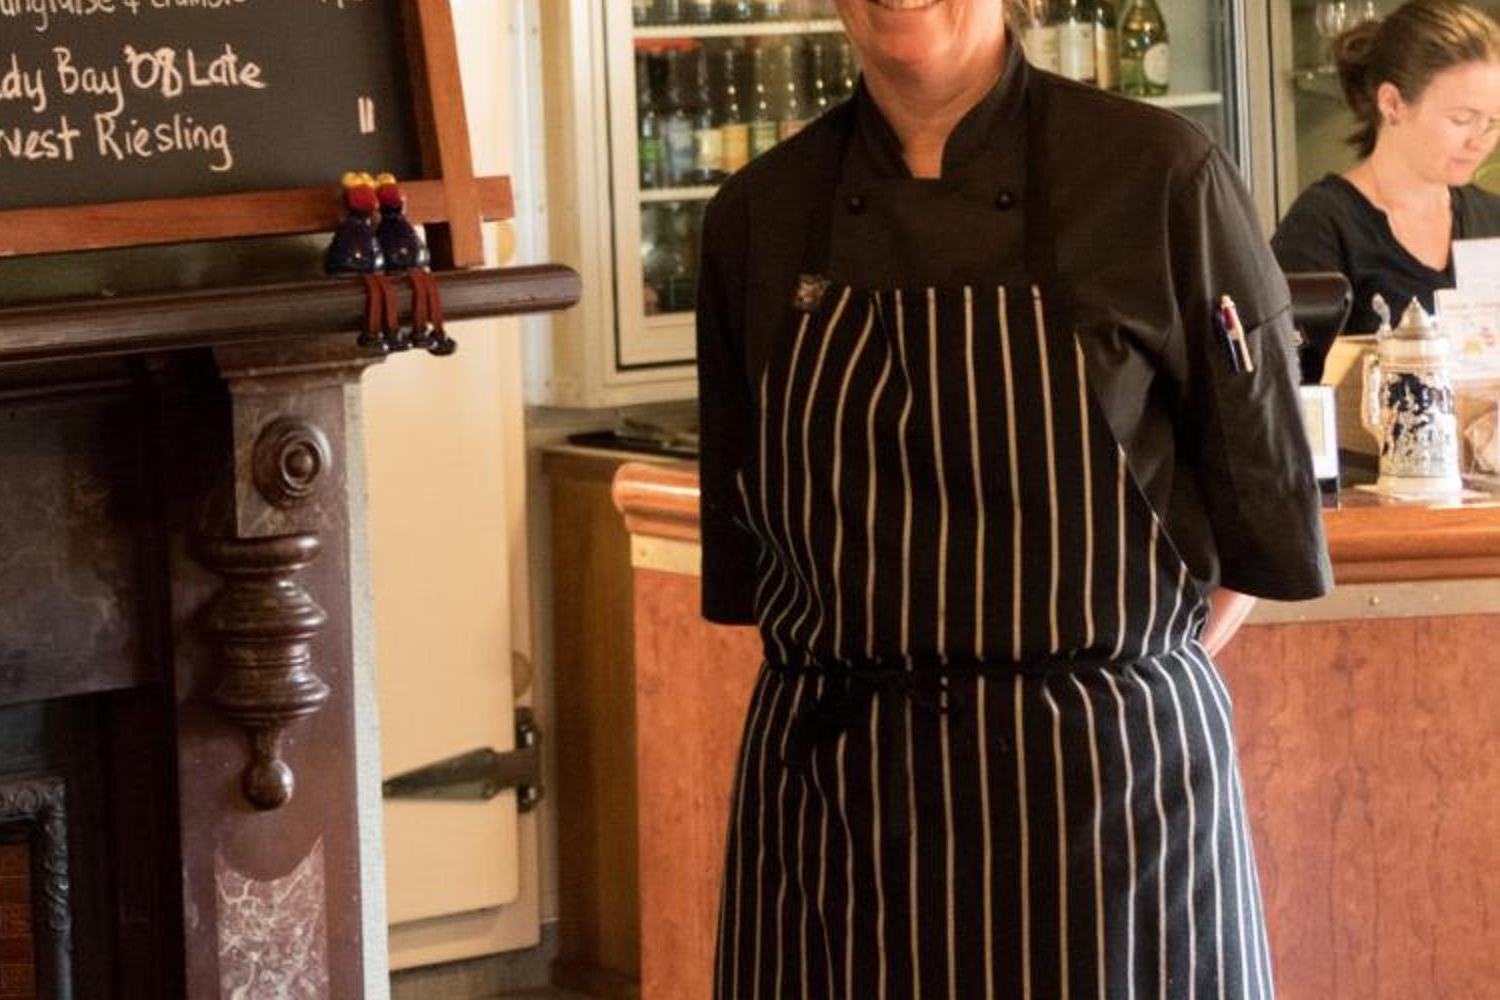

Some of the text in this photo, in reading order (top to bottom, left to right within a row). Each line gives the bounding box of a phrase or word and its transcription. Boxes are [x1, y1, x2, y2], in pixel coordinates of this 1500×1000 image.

[51, 45, 126, 118] Bay
[187, 42, 269, 90] Late
[94, 111, 234, 173] Riesling
